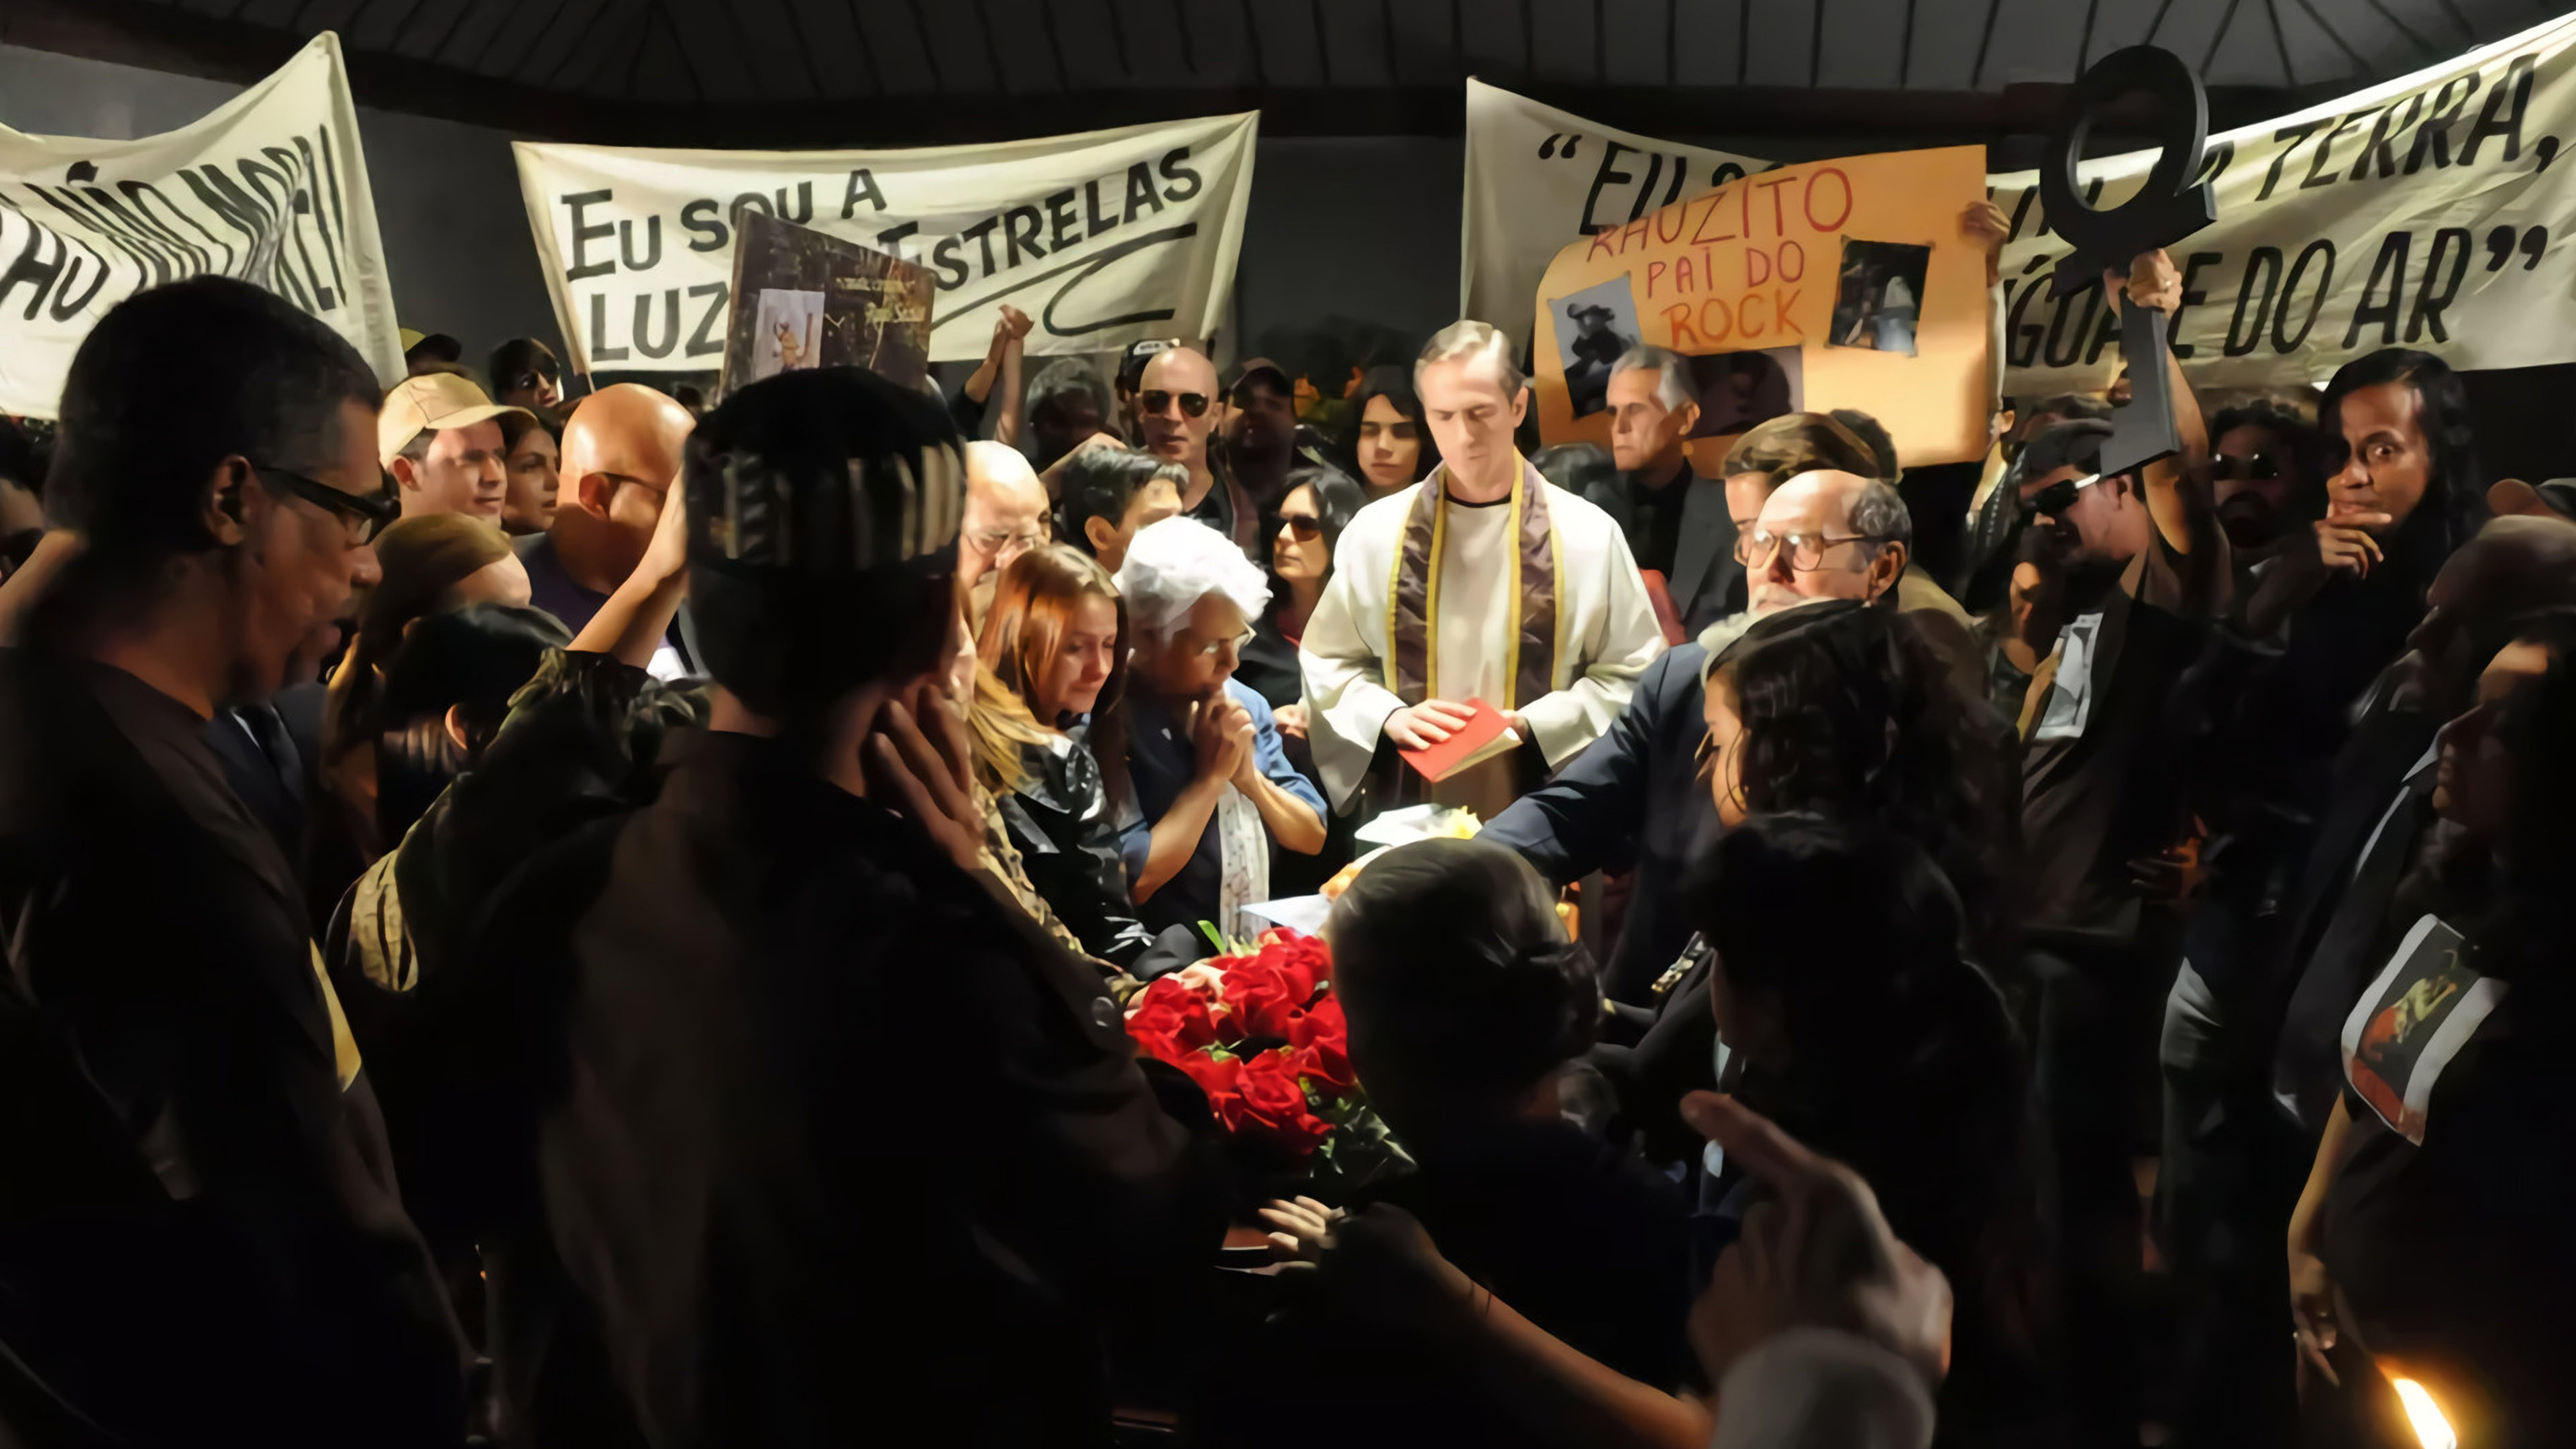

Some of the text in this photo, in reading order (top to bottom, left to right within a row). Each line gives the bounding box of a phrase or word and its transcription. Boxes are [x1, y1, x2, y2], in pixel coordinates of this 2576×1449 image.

[2255, 53, 2560, 201] TERRA,
[561, 187, 661, 282] EU
[841, 168, 887, 219] A
[1747, 239, 1805, 288] DO
[590, 280, 730, 362] LUZ
[1660, 288, 1803, 347] ROCK
[2223, 238, 2337, 357] DO
